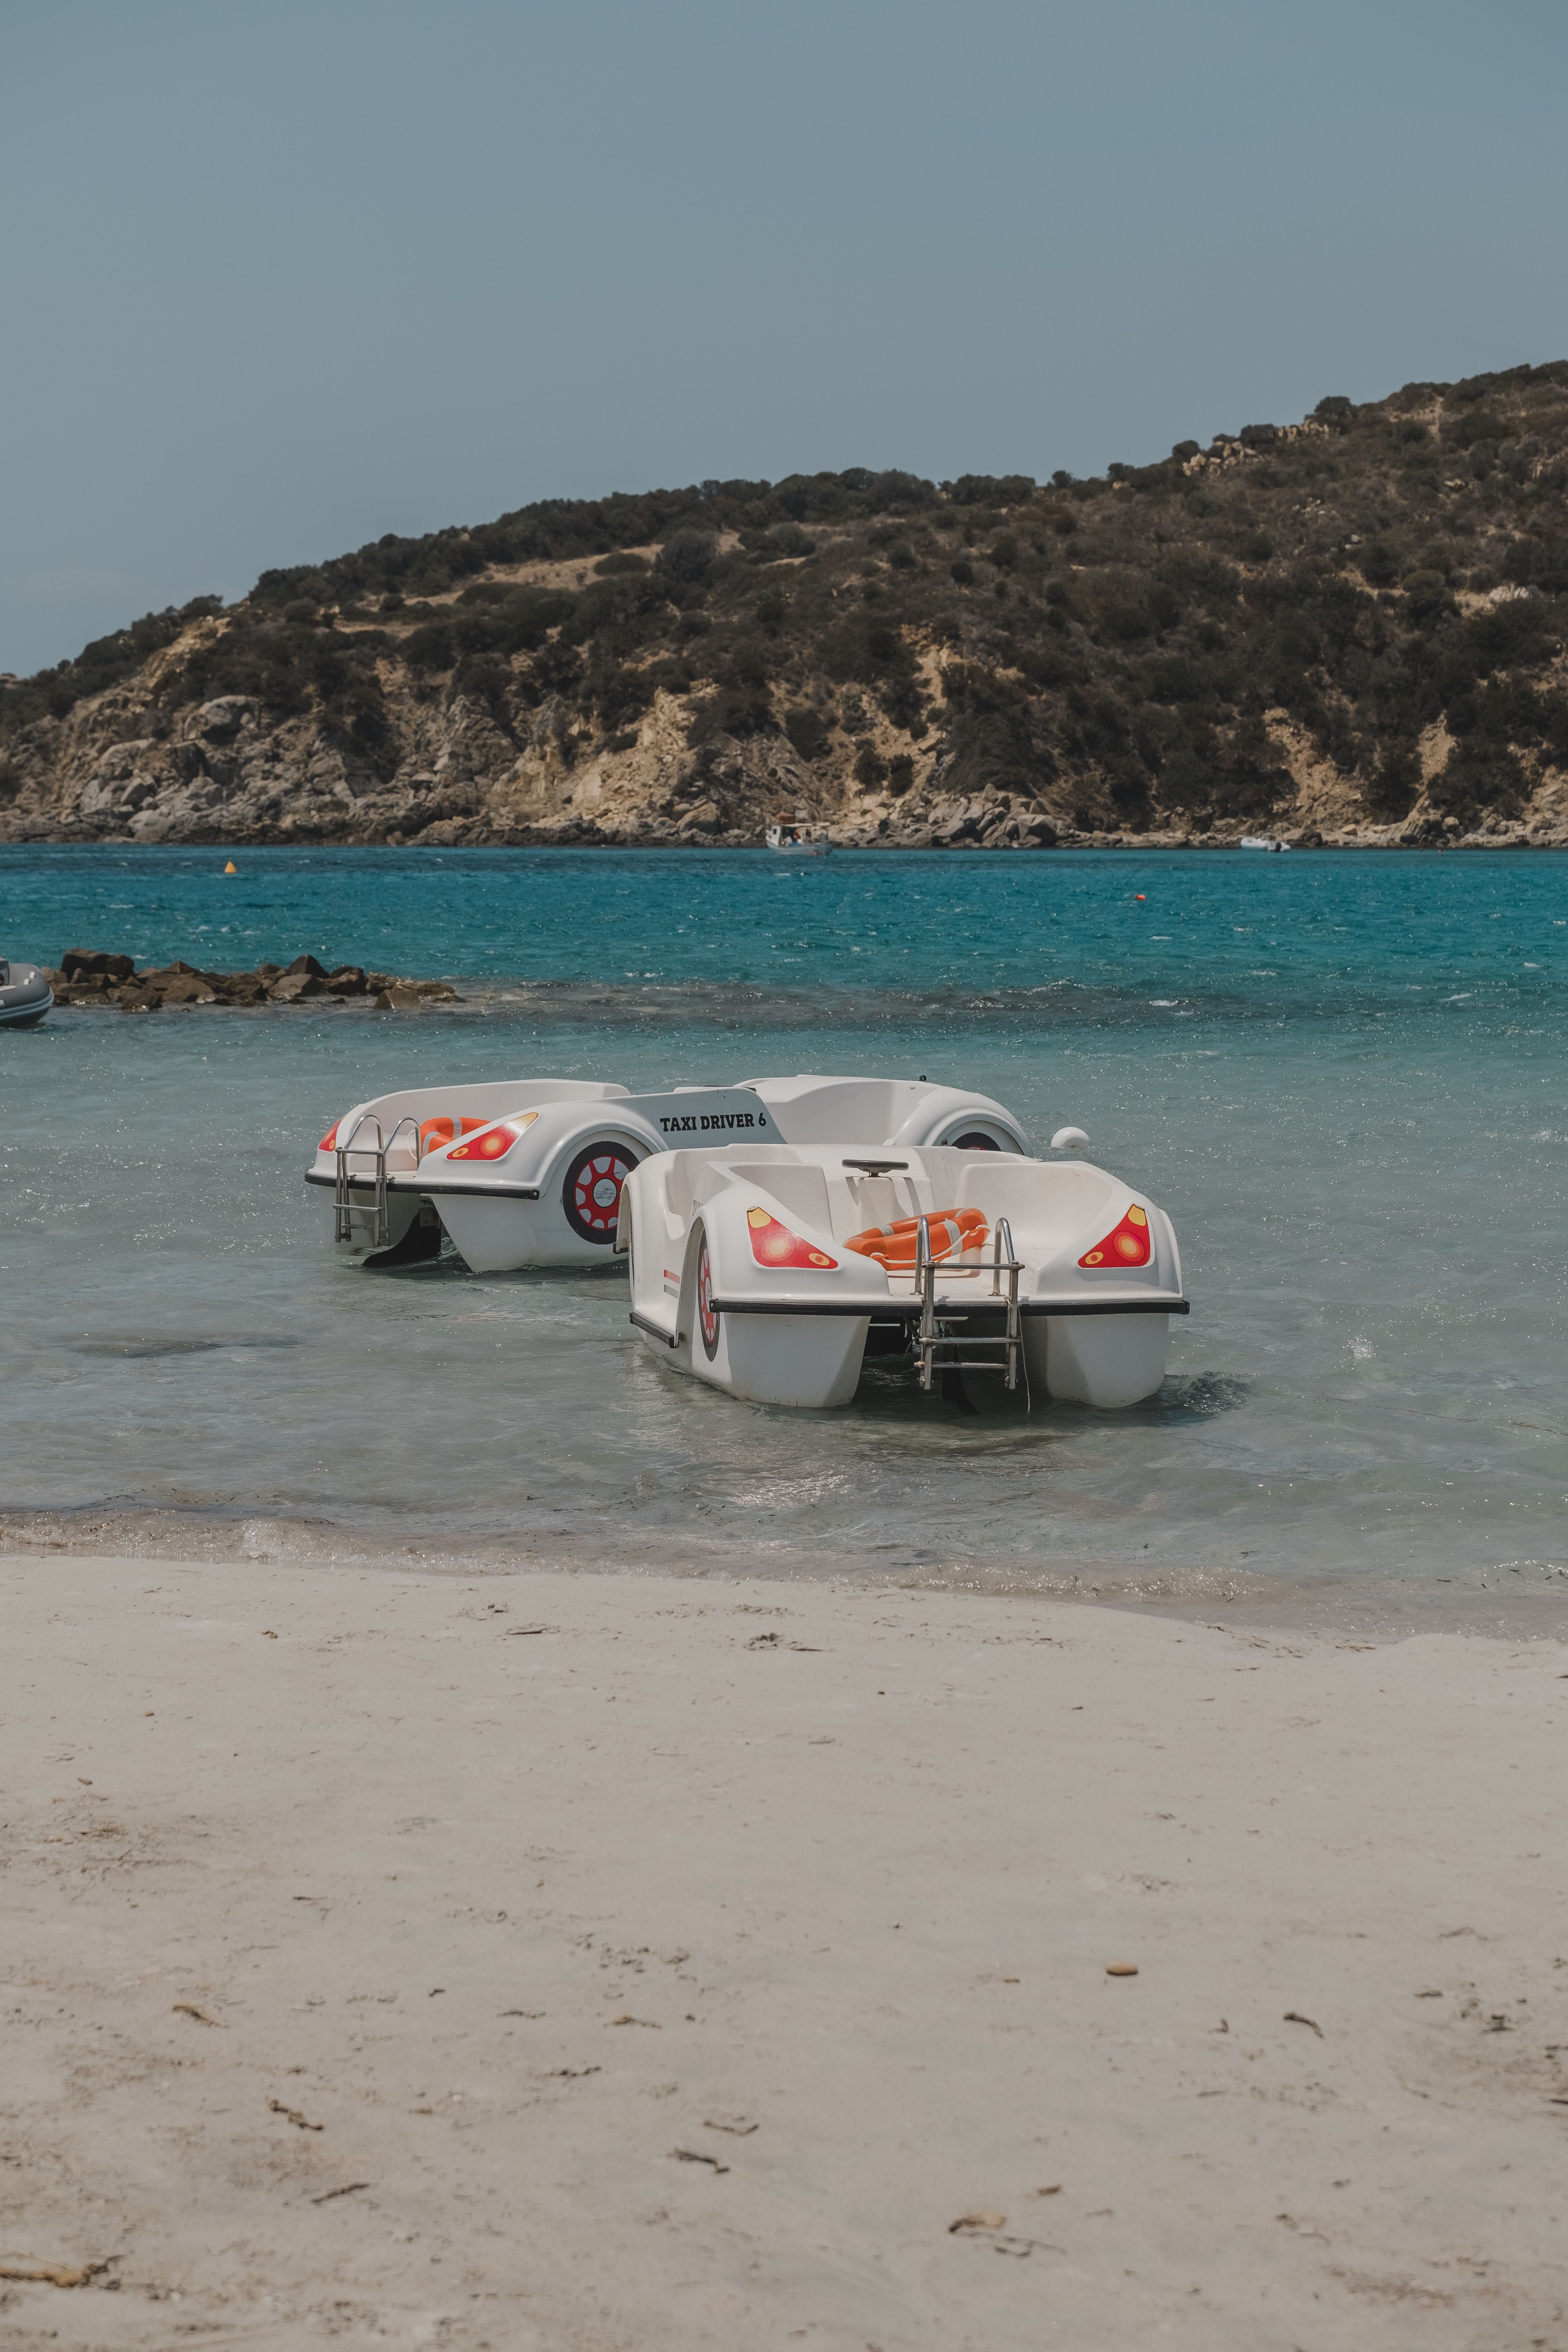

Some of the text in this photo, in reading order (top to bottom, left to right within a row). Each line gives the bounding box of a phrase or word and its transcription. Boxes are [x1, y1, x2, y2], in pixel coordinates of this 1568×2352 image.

[660, 1112, 766, 1132] TAXI DRIVER 6
